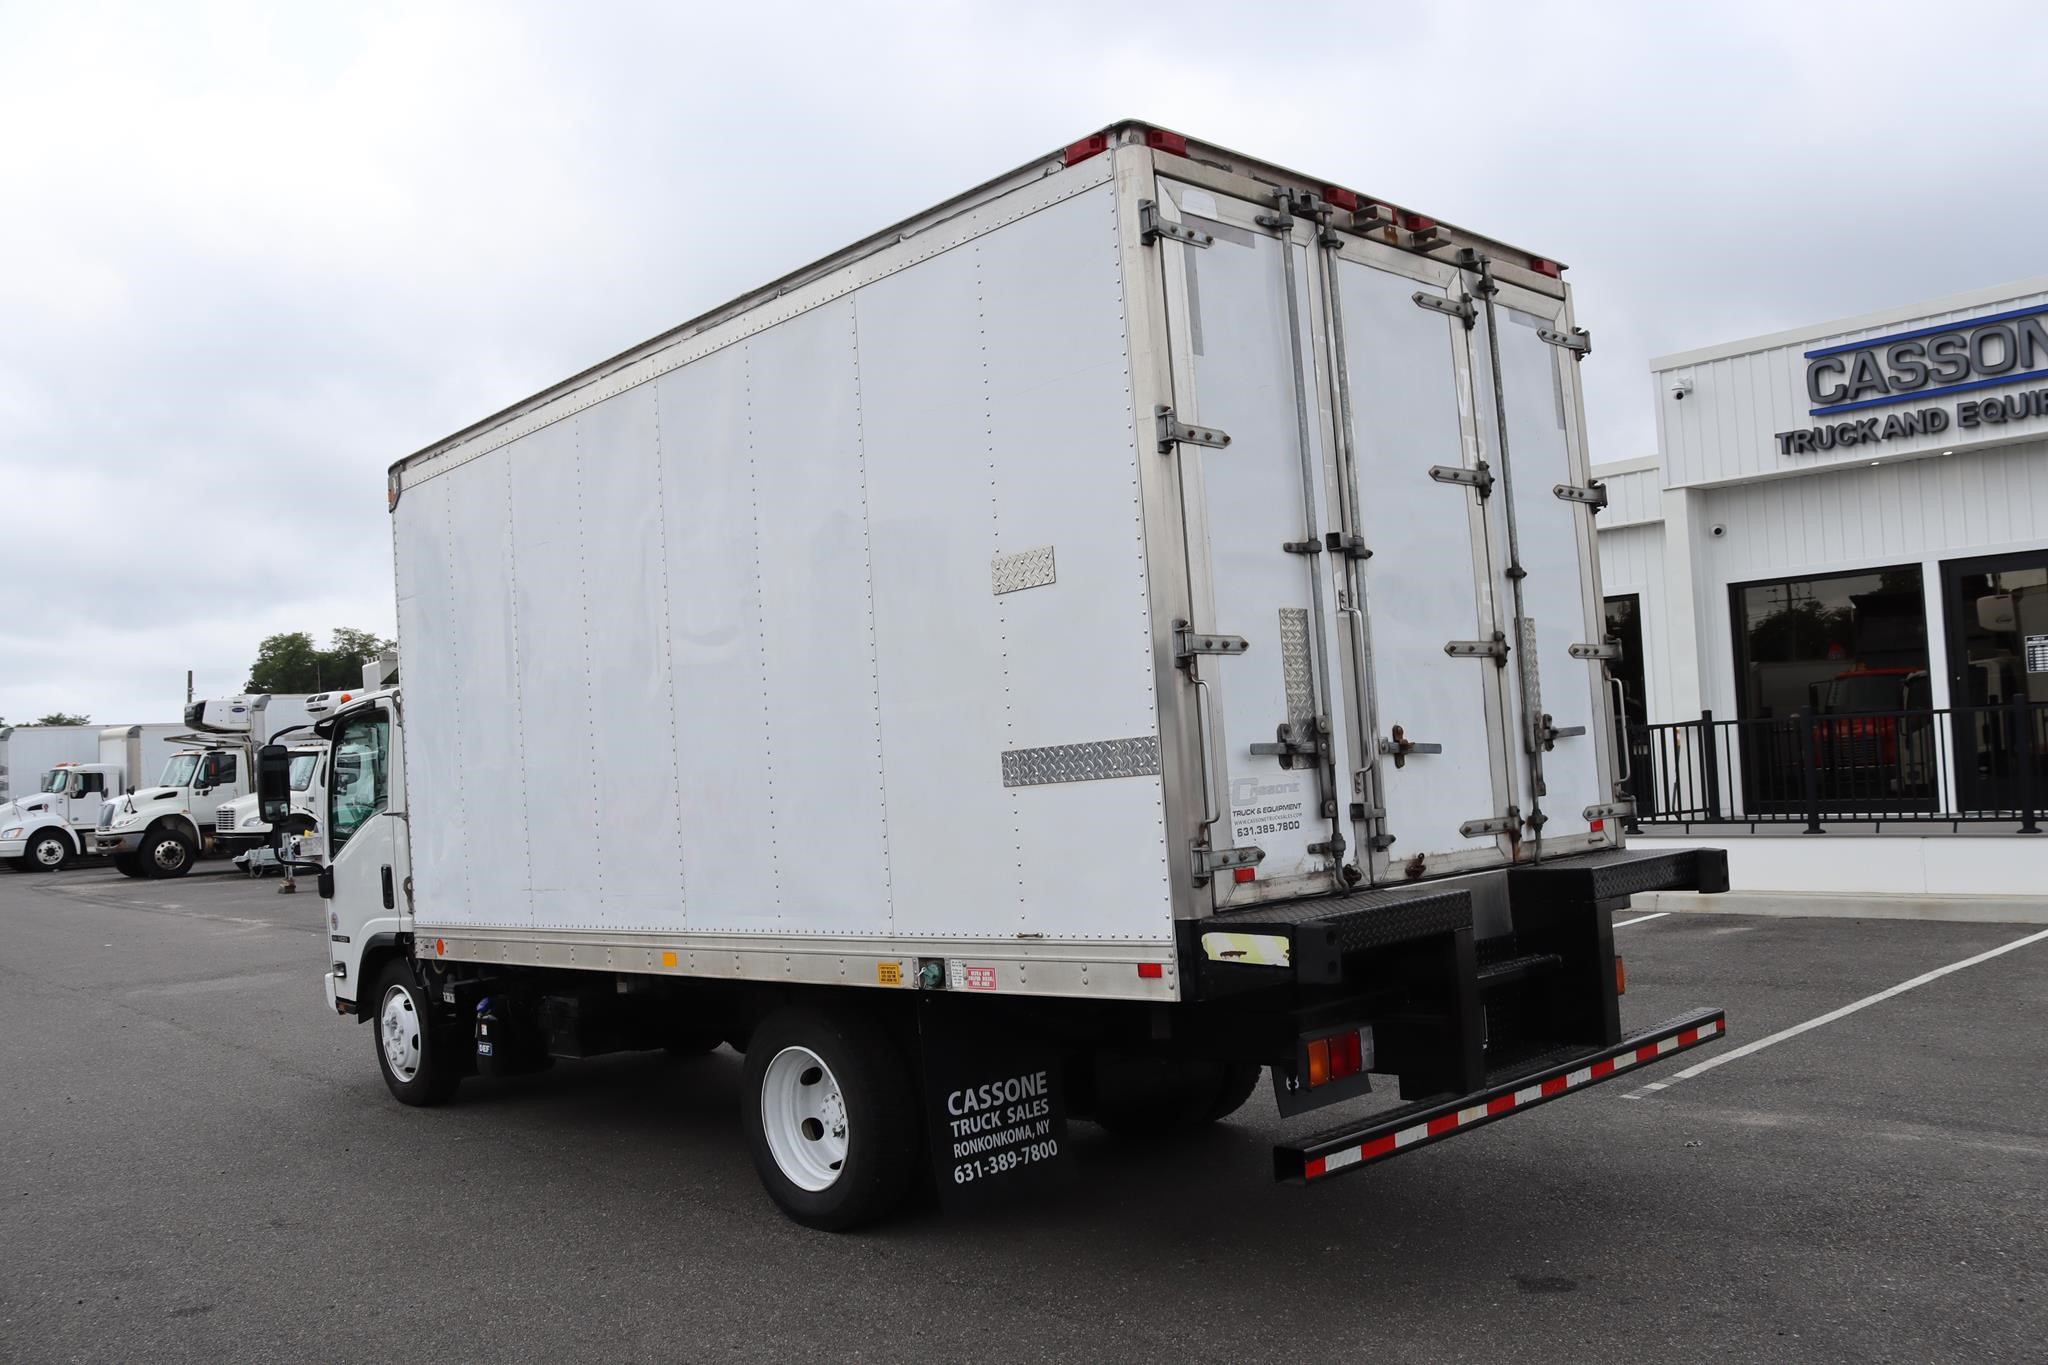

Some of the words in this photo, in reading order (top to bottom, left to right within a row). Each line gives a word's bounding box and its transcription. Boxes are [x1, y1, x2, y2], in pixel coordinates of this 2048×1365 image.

[1775, 417, 1880, 455] TRUCK
[1882, 406, 1949, 440] AND
[1232, 808, 1256, 818] TRUCK
[1256, 807, 1262, 815] &
[1263, 803, 1302, 814] EQUIPMENT
[1237, 820, 1300, 837] 631.389.7800
[947, 1071, 1048, 1116] CASSONE
[950, 1110, 1002, 1138] TRUCK
[1006, 1098, 1049, 1124] SALES
[953, 1124, 1035, 1159] RONKONKOMA,
[1036, 1119, 1050, 1136] NY
[954, 1139, 1058, 1184] 631-389-7800
